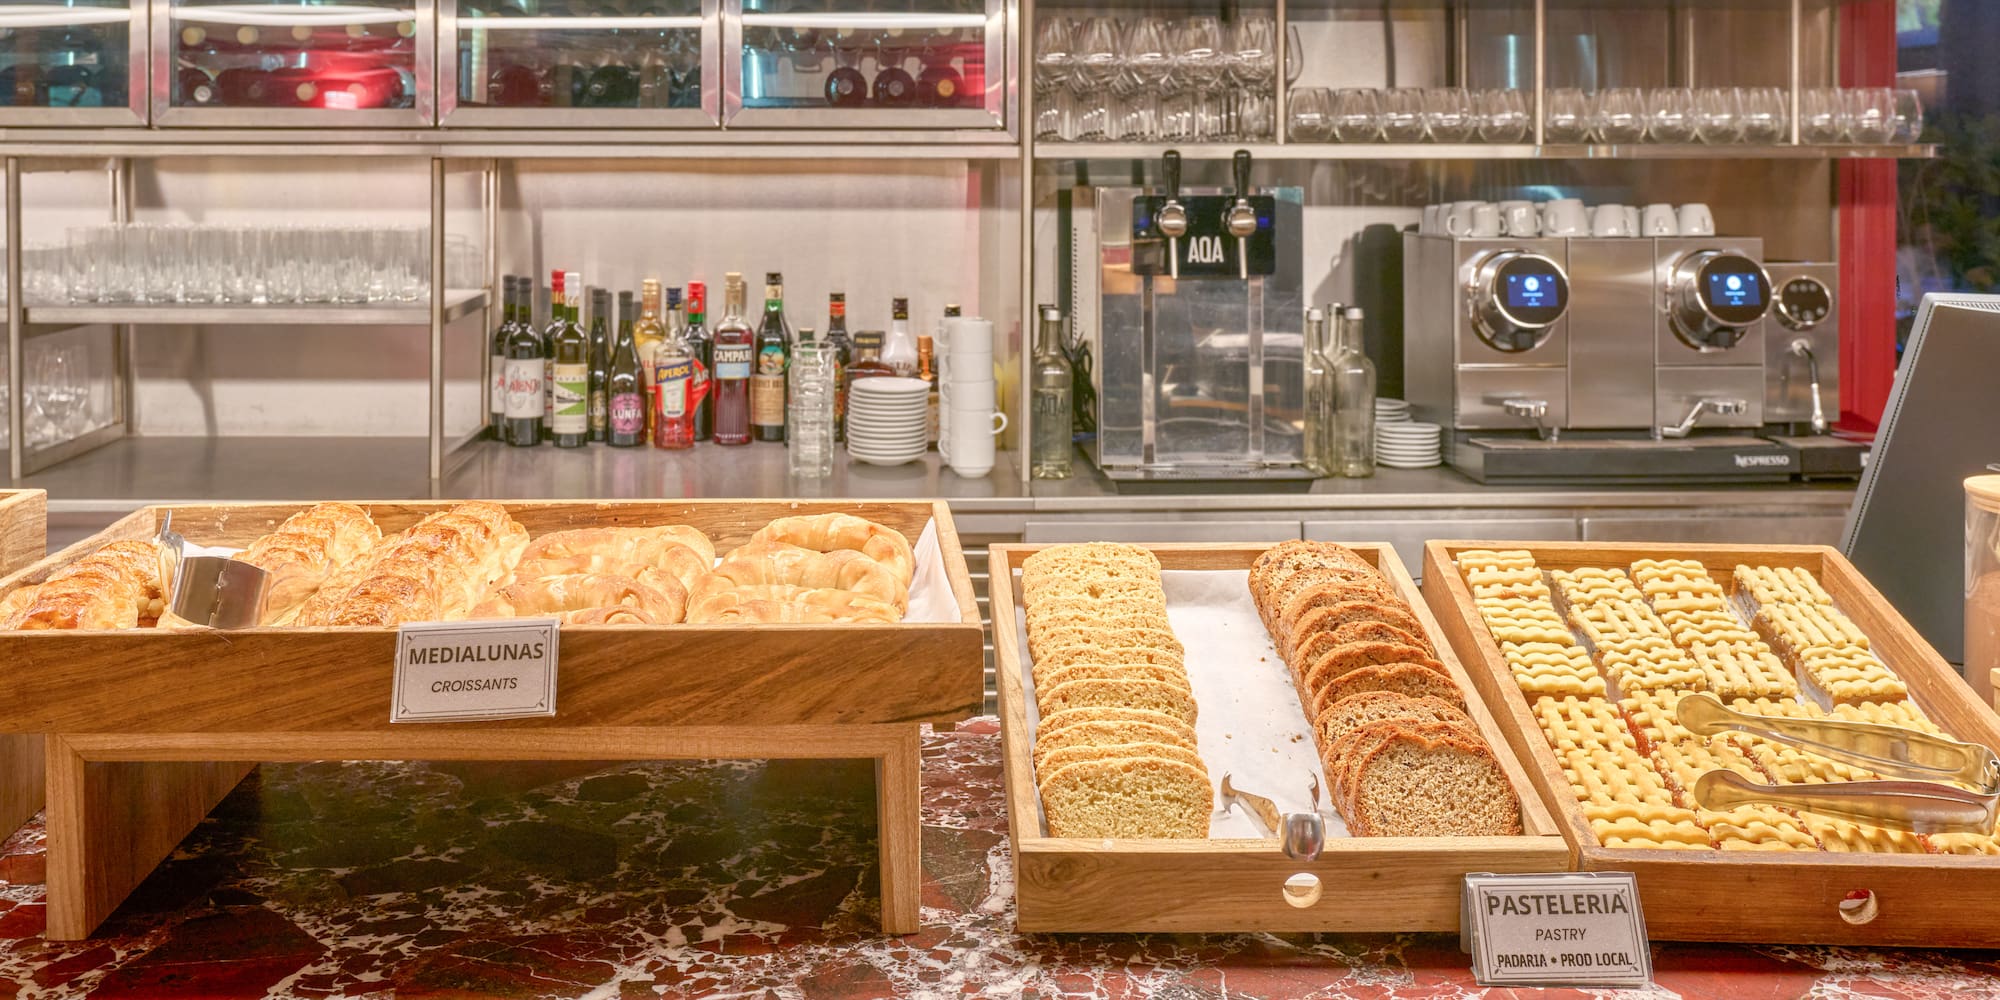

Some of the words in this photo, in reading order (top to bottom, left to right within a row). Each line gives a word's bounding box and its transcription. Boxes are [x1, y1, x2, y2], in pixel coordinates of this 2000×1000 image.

[1187, 236, 1224, 263] AQA
[657, 364, 690, 380] APEROL
[612, 408, 643, 419] LUNFA
[1734, 455, 1790, 467] NESPRESSO
[409, 642, 544, 665] MEDIALUNAS
[431, 677, 518, 693] CROISSANTS
[1487, 893, 1628, 916] PASTELERIA
[1535, 928, 1587, 941] PASTRY
[1497, 954, 1548, 968] PADARIA
[1561, 953, 1592, 967] PROD
[1595, 952, 1633, 967] LOCAL
